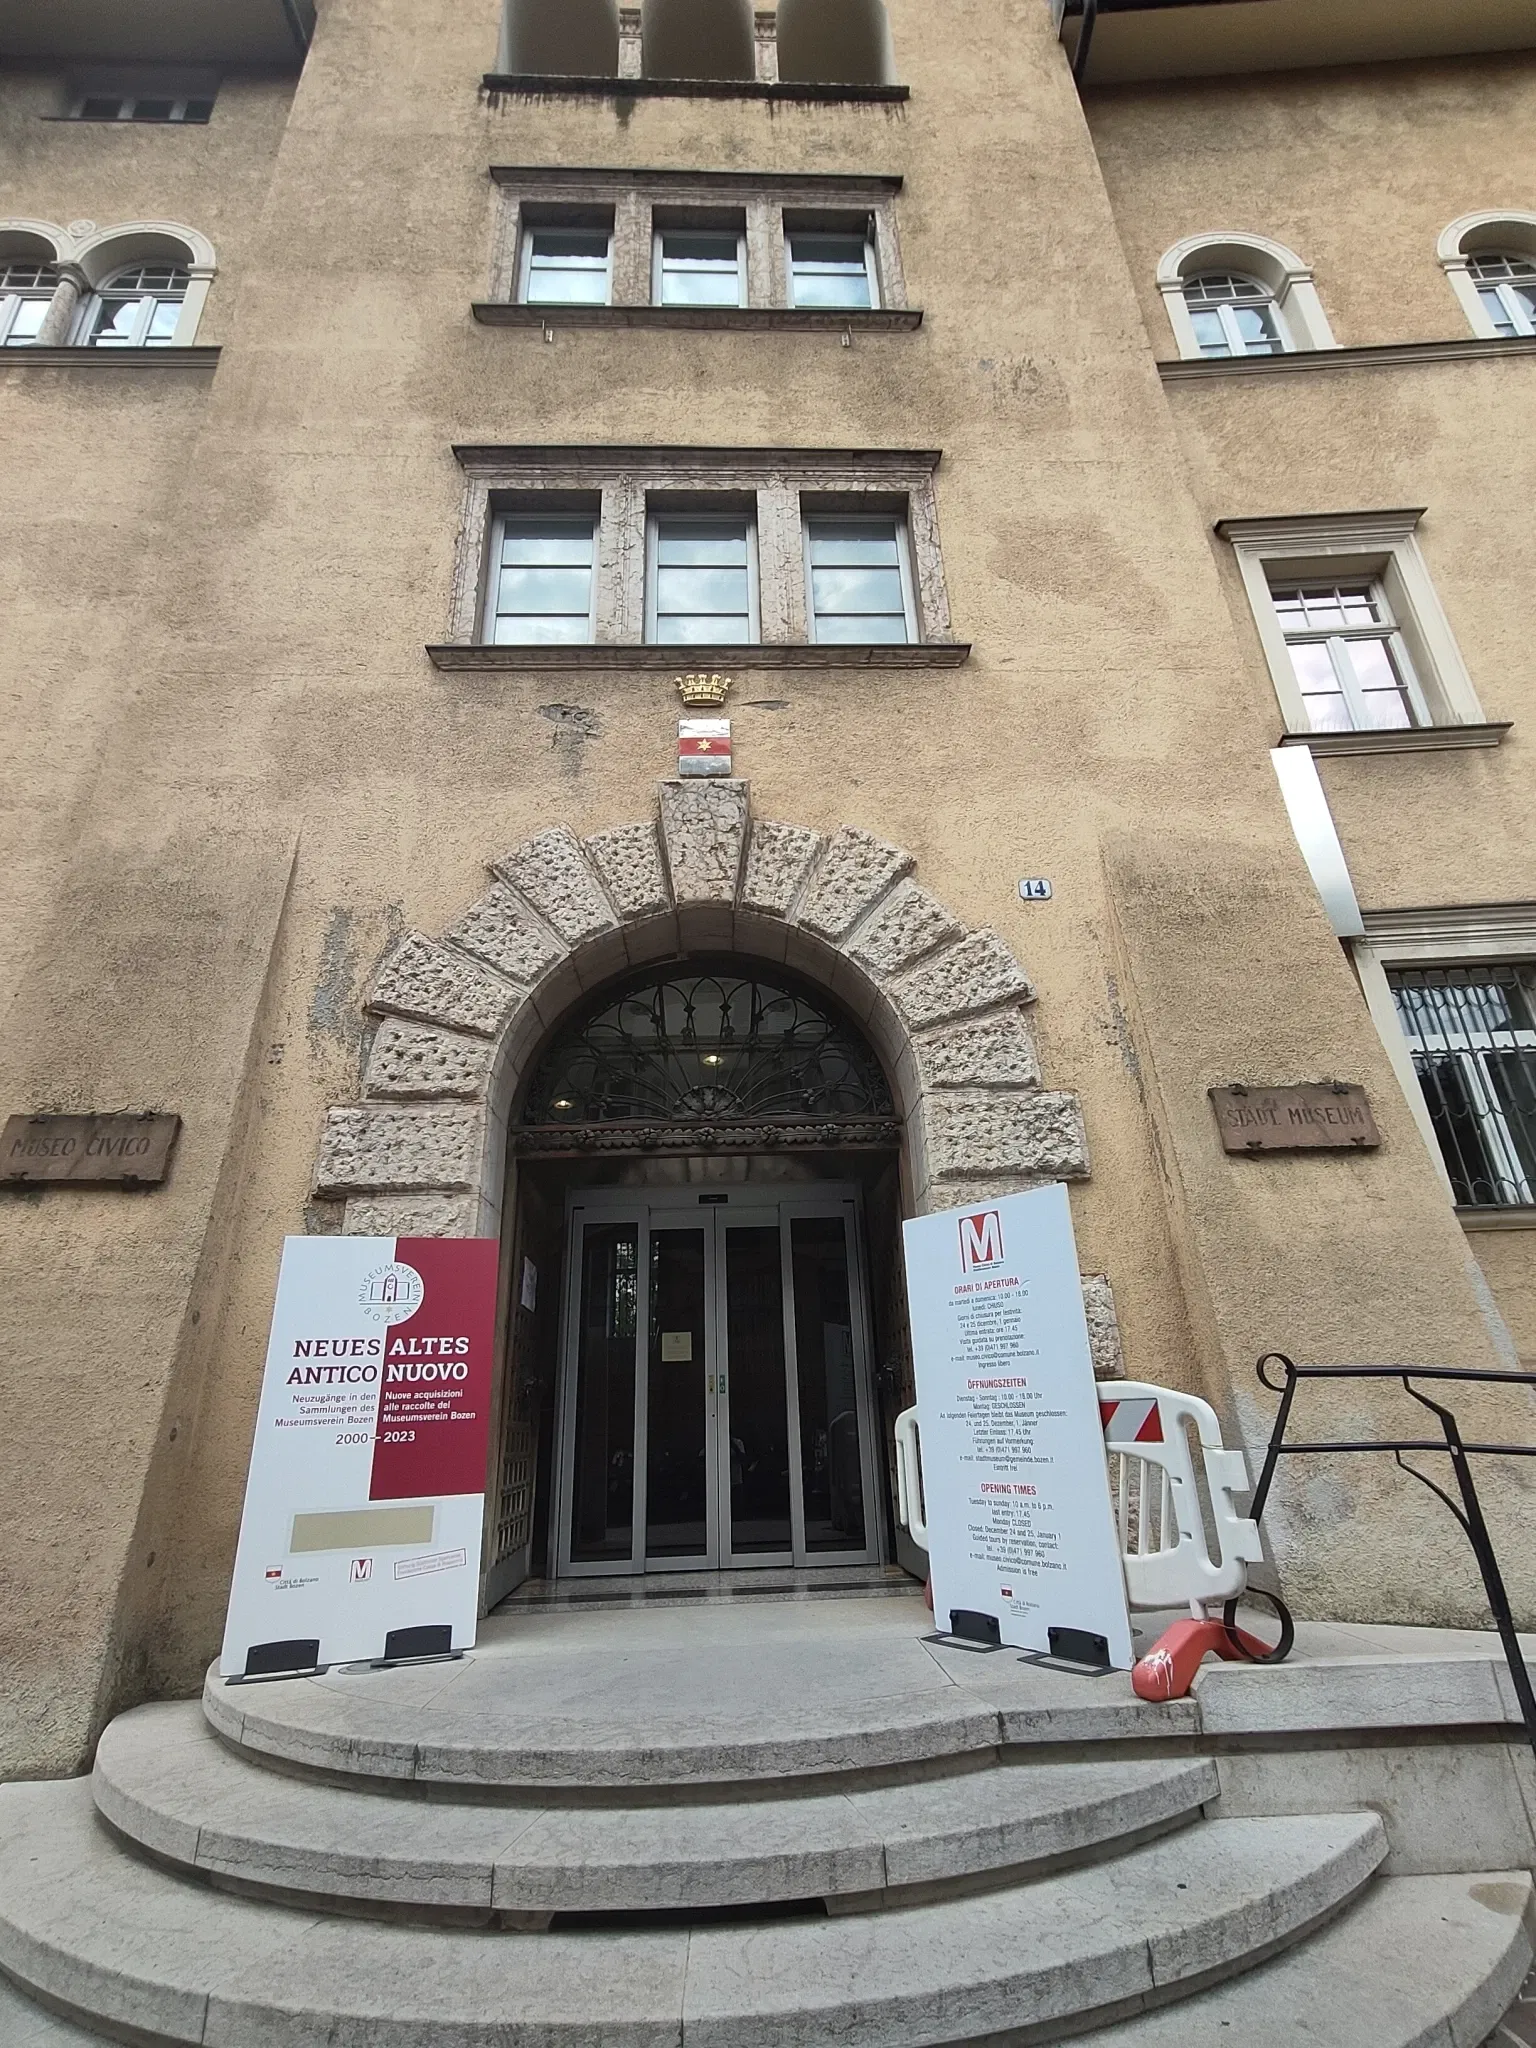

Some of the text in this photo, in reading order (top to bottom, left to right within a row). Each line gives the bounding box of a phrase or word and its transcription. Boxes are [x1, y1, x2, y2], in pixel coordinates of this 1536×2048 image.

[1024, 881, 1046, 896] 14
[1288, 1107, 1365, 1125] MUSEUM
[10, 1136, 150, 1157] MUSEO CIVICO
[358, 1264, 421, 1302] MUSEUMSVEREIN
[955, 1277, 1019, 1294] ORARI DI APERTURA
[987, 1301, 1004, 1310] CHIUSO
[364, 1306, 412, 1324] BOZEN
[293, 1337, 470, 1357] NEUES ALTES
[978, 1361, 996, 1369] Ingresso
[286, 1363, 468, 1385] ANTICO NUOVO
[968, 1378, 1027, 1389] ÖFFNUNGSZEITEN
[292, 1393, 376, 1405] Neuzugänge in den
[385, 1389, 463, 1400] Nuove acquisizioni
[957, 1394, 975, 1402] Dienstag
[979, 1394, 997, 1402] Sonntag
[299, 1404, 375, 1415] Sammlungen des
[384, 1401, 451, 1411] alle raccolte del
[383, 1411, 476, 1423] Museumsverein Bozen
[1014, 1410, 1034, 1418] Museum
[275, 1416, 374, 1428] Museumsverein Bozen
[1022, 1419, 1038, 1427] Jänner
[972, 1437, 996, 1445] Führungen
[981, 1483, 1037, 1496] OPENING TIMES
[969, 1497, 987, 1507] Tuesday
[1042, 1503, 1054, 1511] p.m.
[992, 1508, 1000, 1516] last
[993, 1517, 1031, 1528] Monday CLOSED
[973, 1533, 988, 1542] Guided
[989, 1535, 1001, 1543] tours
[1002, 1536, 1008, 1545] by
[985, 1525, 1008, 1534] December
[1036, 1530, 1057, 1541] January
[1034, 1549, 1045, 1558] 960
[997, 1564, 1021, 1575] Admission
[1028, 1568, 1038, 1577] free
